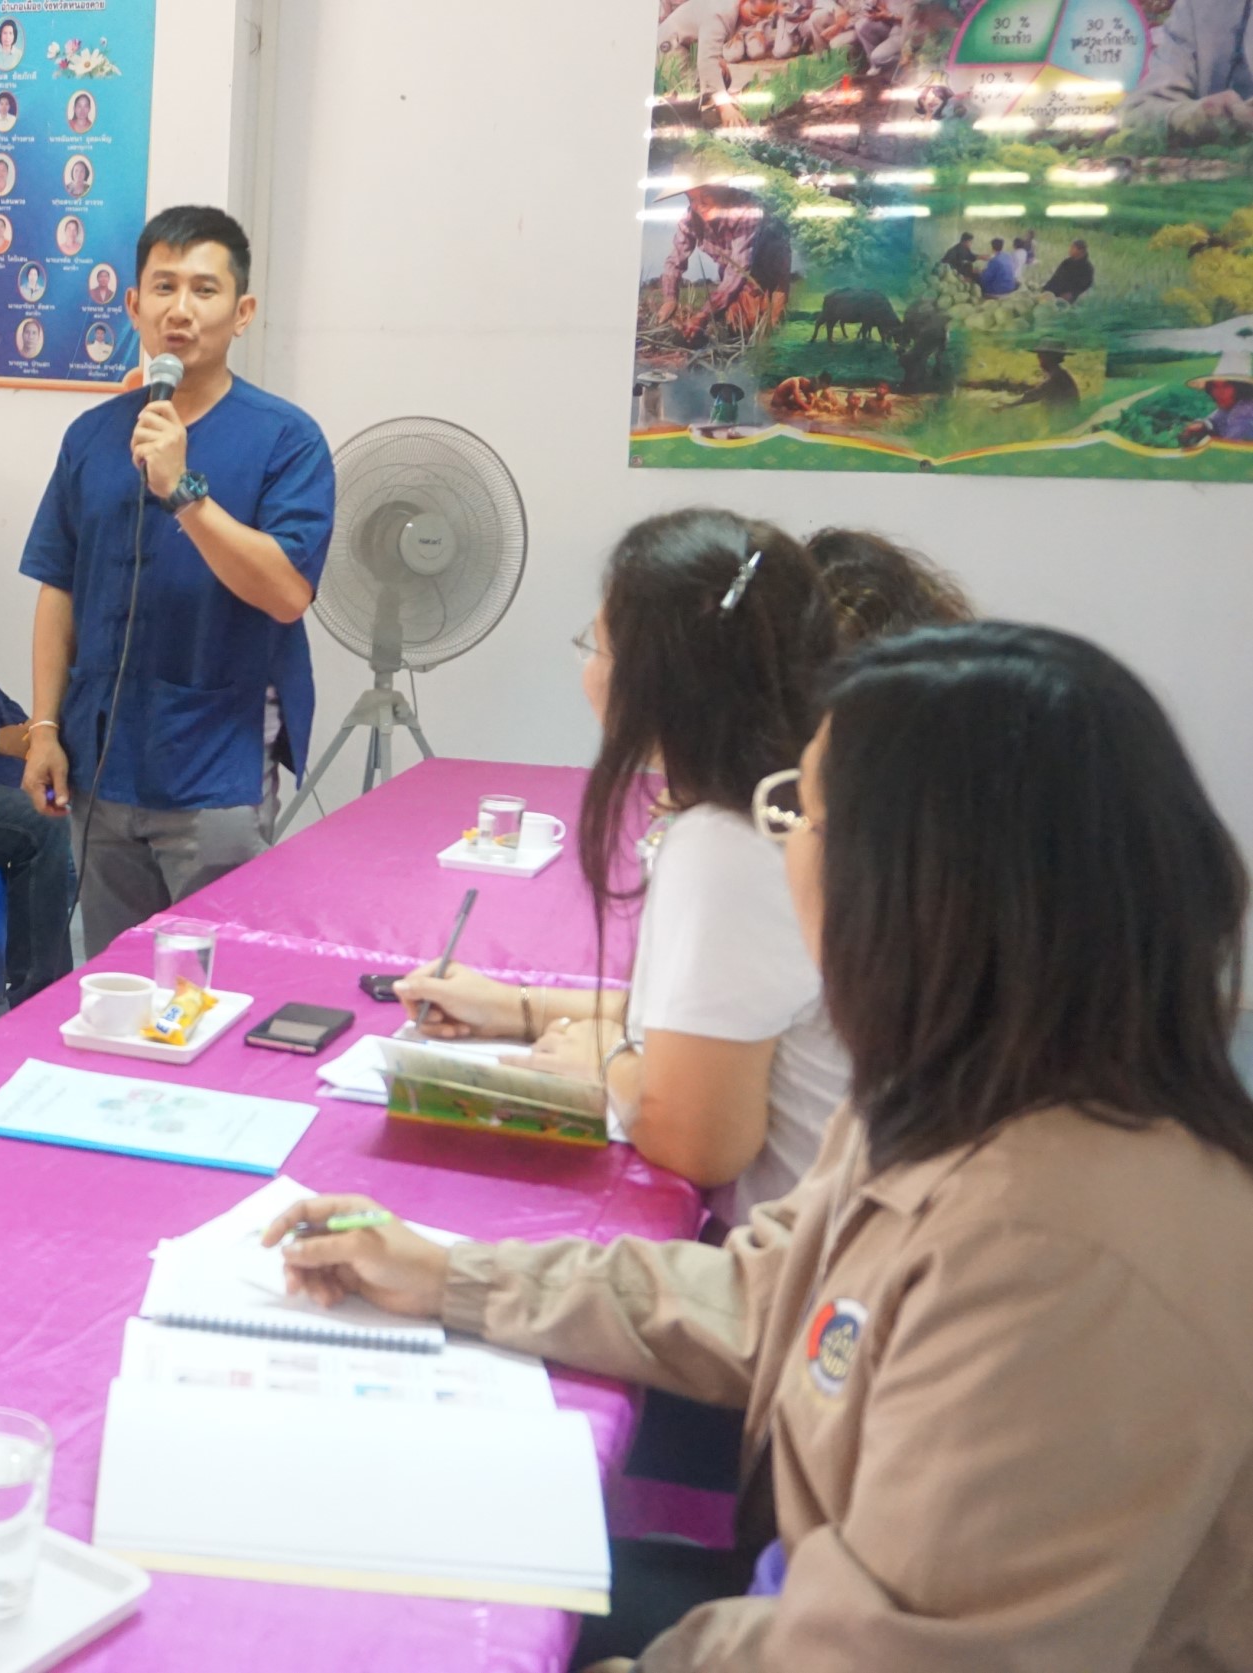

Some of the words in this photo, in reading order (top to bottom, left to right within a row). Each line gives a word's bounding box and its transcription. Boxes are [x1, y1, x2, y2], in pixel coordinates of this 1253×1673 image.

[994, 17, 1010, 29] 30
[1087, 19, 1103, 31] 30
[980, 73, 995, 84] 10
